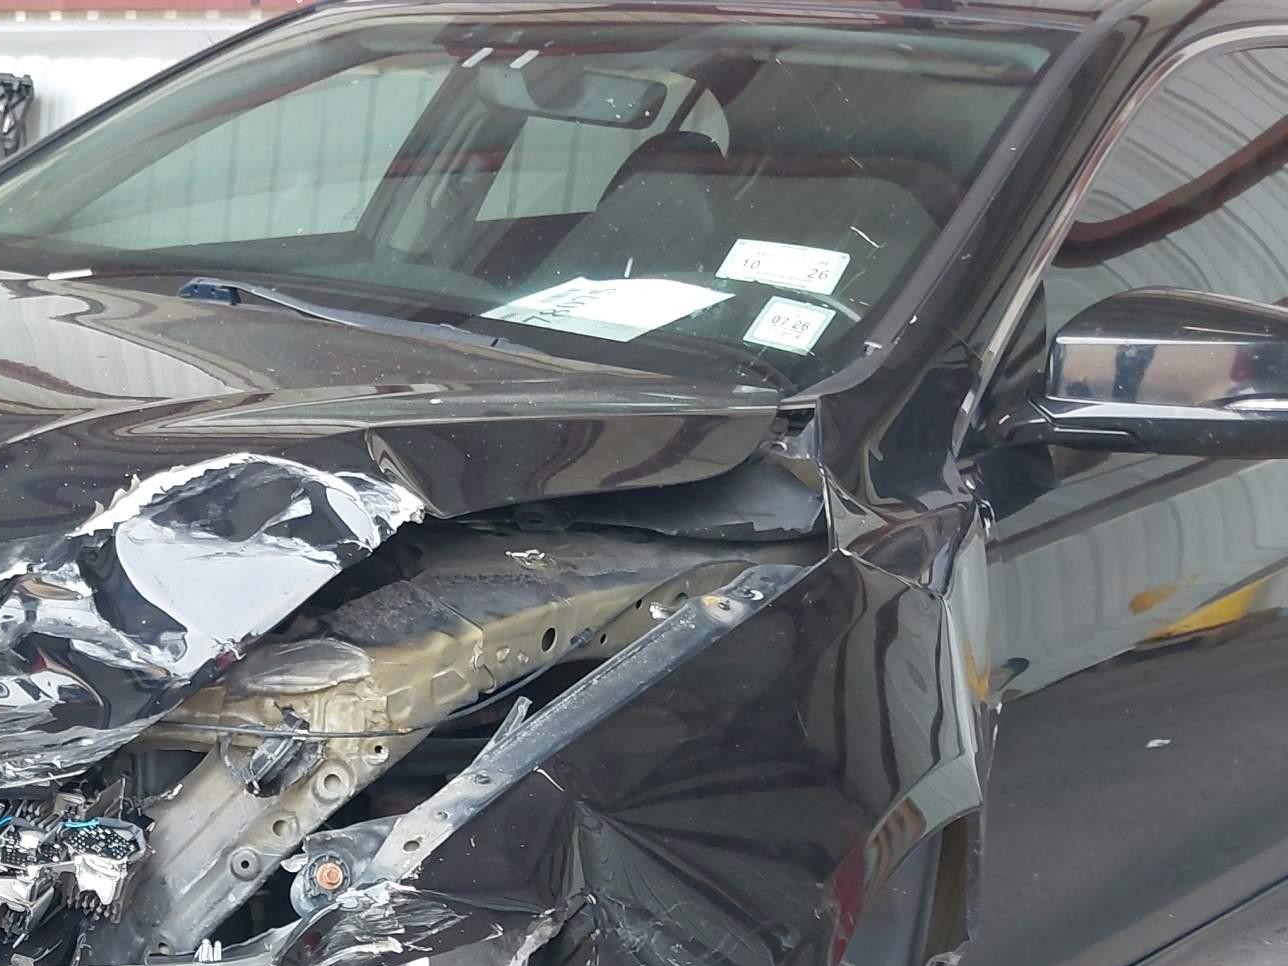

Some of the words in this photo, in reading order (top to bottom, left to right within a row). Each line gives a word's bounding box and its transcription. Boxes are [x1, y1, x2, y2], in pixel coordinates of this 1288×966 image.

[742, 258, 762, 270] 10
[807, 268, 830, 280] 26
[771, 314, 790, 326] 07
[791, 319, 811, 332] 26
